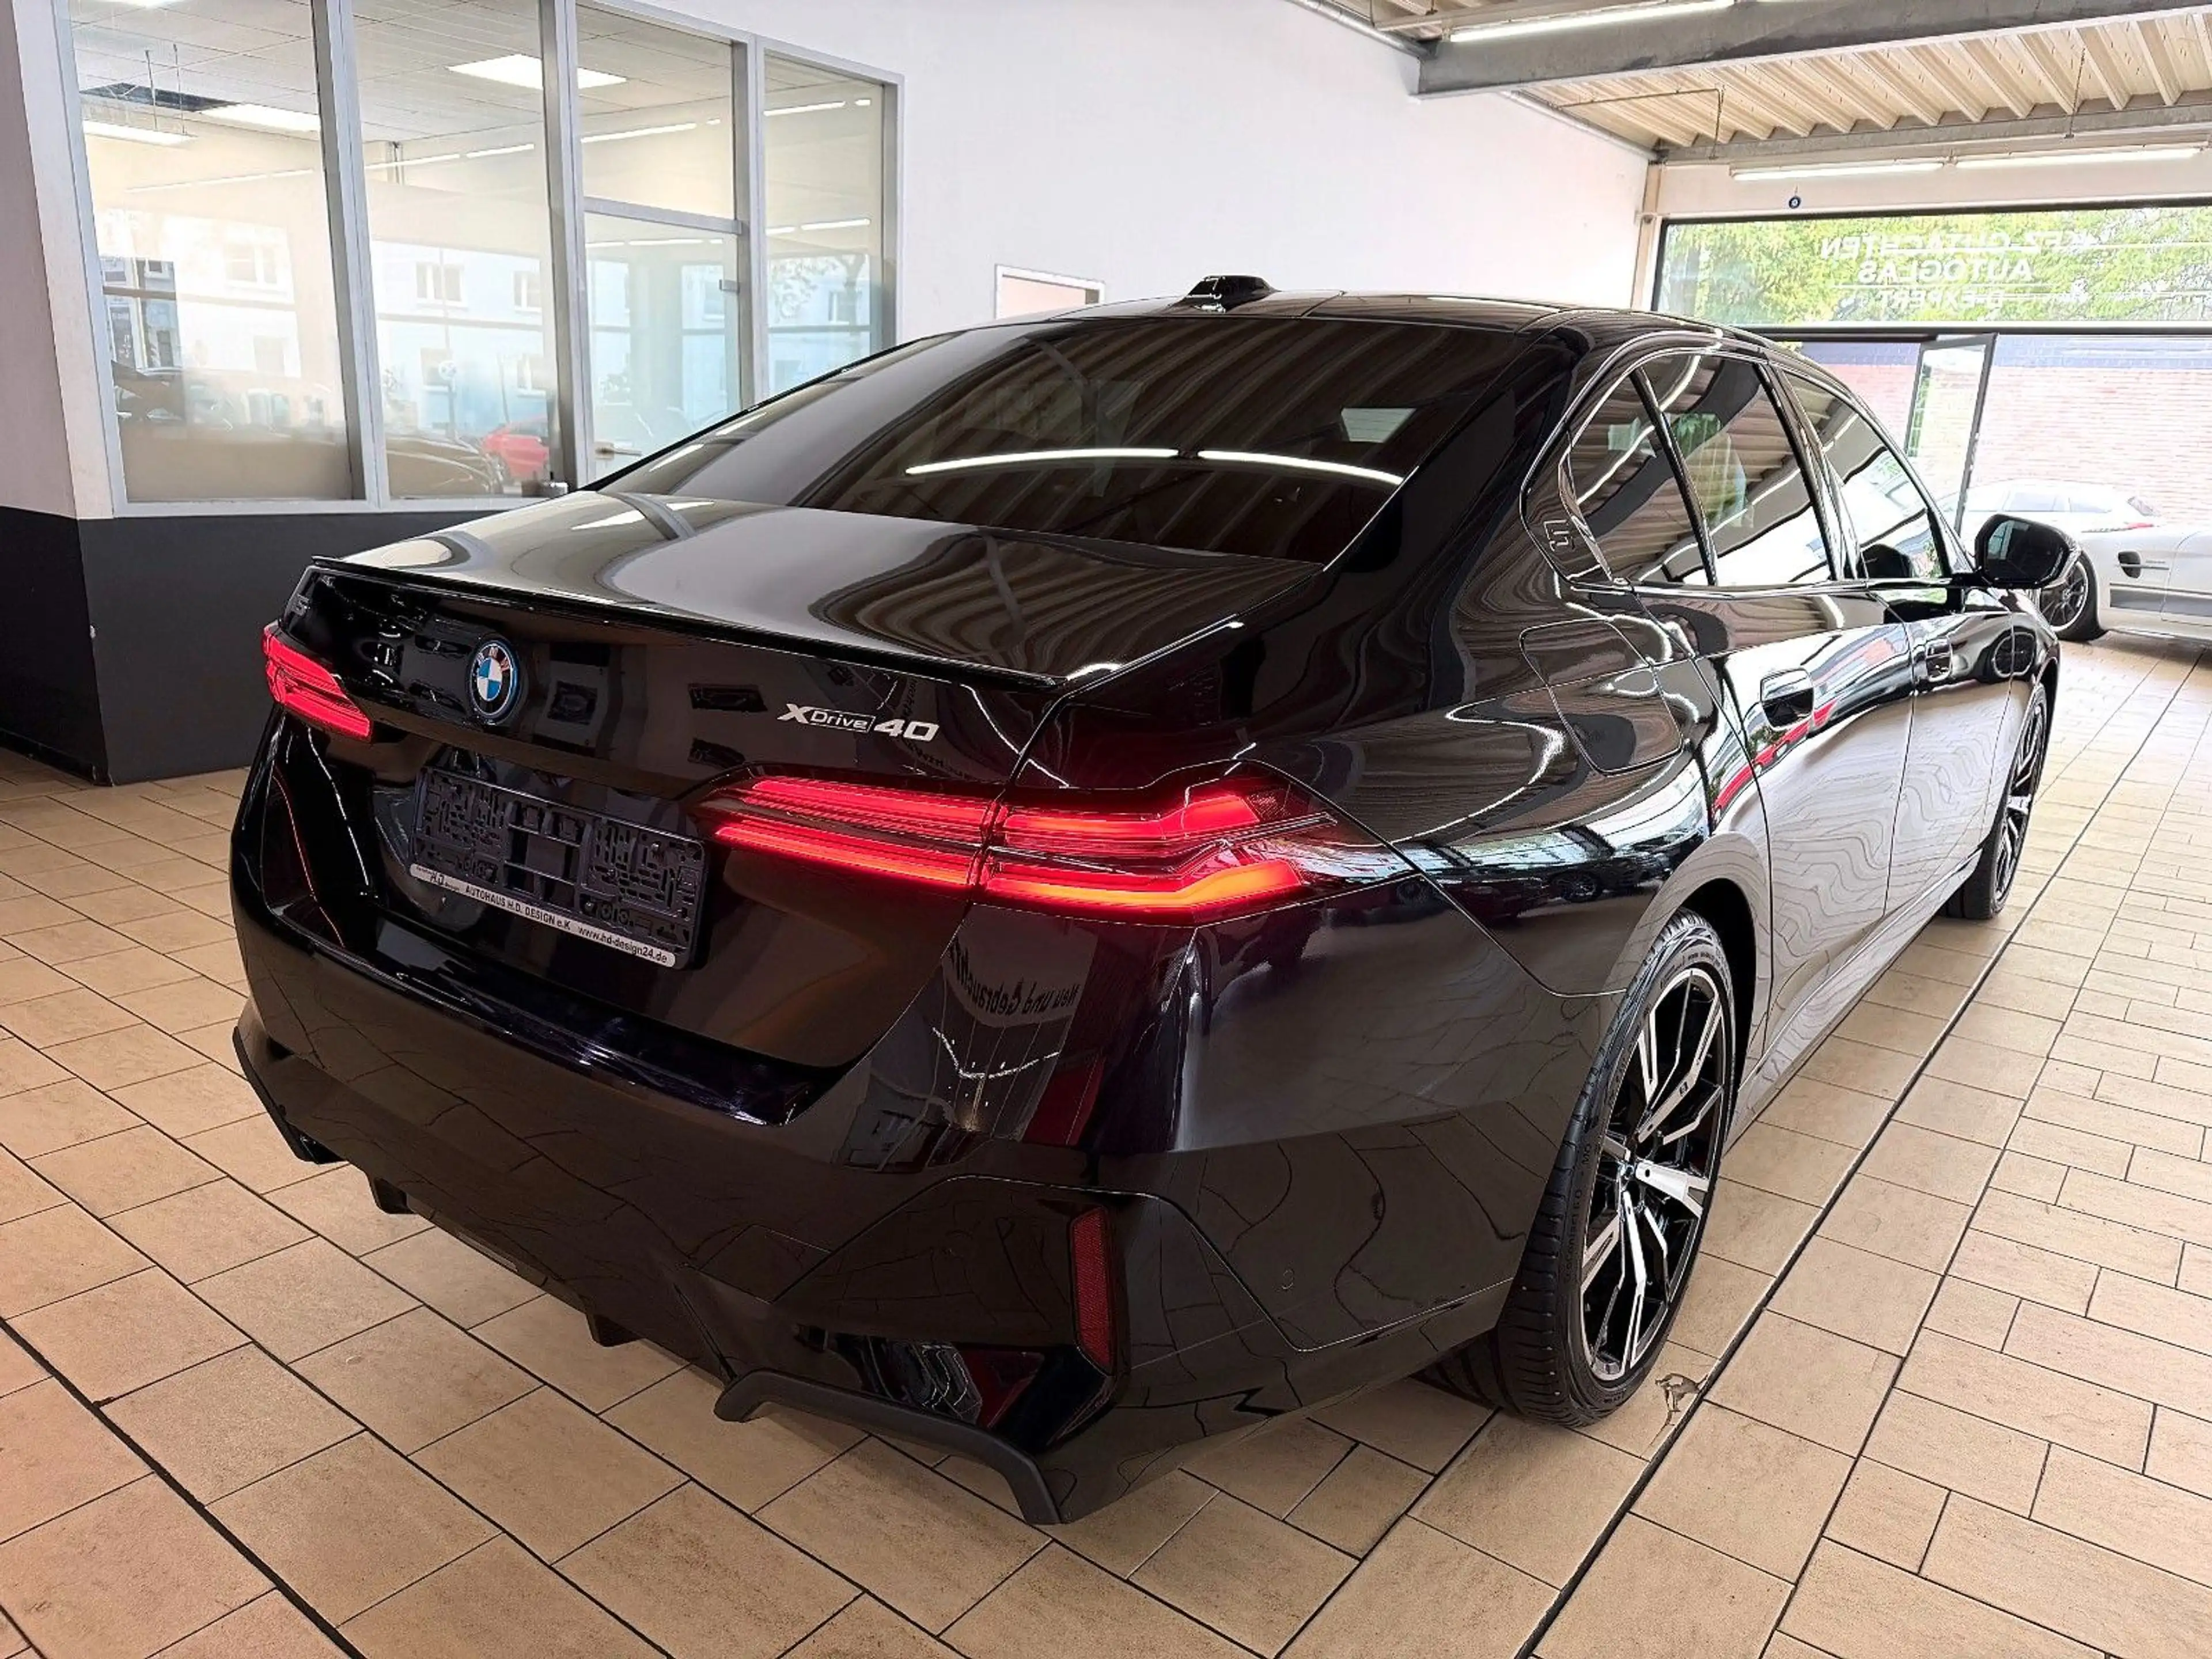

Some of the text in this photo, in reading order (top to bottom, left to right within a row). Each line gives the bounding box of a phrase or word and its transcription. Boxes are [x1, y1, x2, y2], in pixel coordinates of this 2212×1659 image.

[477, 645, 510, 672] BMW
[873, 718, 940, 741] 40
[465, 884, 506, 906] AUTOHAUS
[525, 906, 555, 922] DESIGN
[577, 925, 668, 963] www.hd-design24.de
